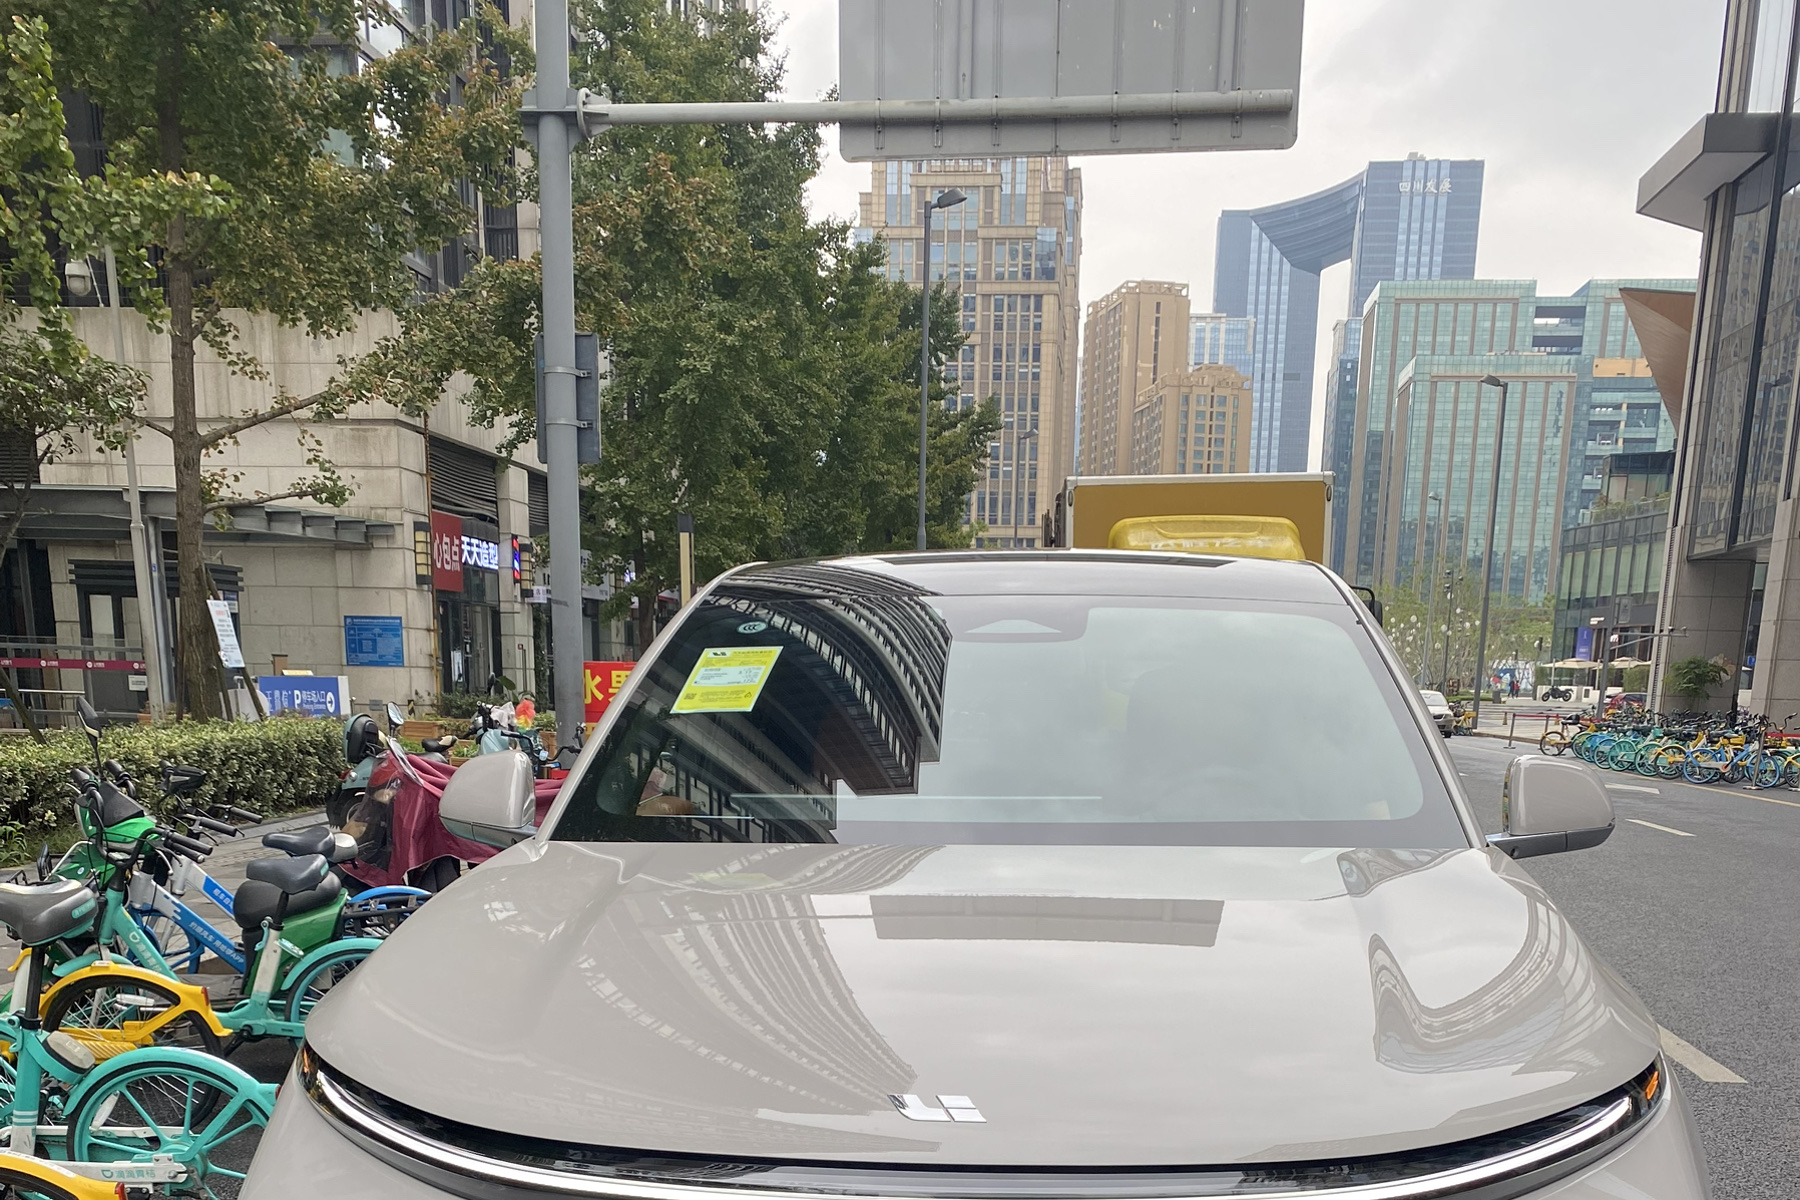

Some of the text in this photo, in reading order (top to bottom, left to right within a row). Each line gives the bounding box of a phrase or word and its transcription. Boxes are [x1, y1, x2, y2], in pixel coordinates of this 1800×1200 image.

[1399, 178, 1452, 193] 四川发展
[461, 535, 499, 570] 天天造型
